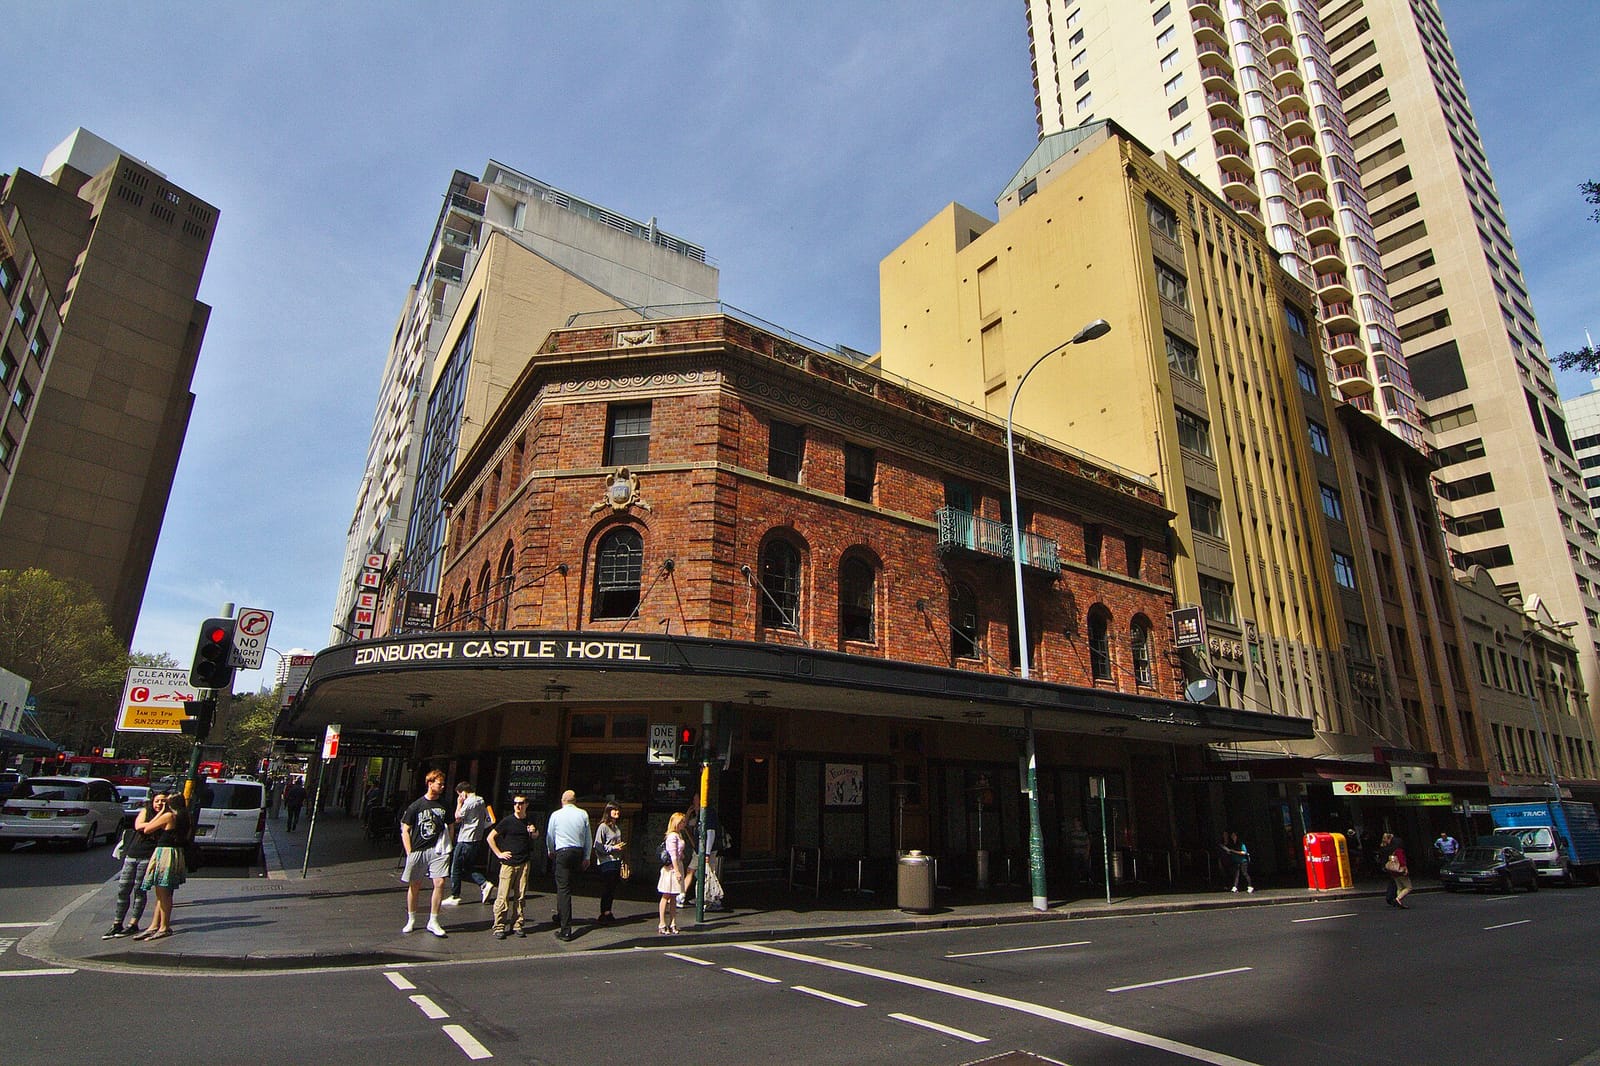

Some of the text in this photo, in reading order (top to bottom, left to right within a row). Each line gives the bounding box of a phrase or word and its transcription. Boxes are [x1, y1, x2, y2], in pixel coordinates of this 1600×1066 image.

[358, 556, 380, 640] CHEMI
[240, 637, 258, 648] NO
[233, 648, 261, 656] RIGHT
[354, 640, 651, 665] EDINBURGH CASTLE HOTEL
[233, 656, 257, 665] TURN
[292, 657, 314, 665] For Lea
[138, 670, 187, 679] CLEARWA
[132, 678, 165, 686] SPECIAL
[134, 688, 146, 702] C
[654, 727, 673, 737] ONE
[653, 739, 674, 748] WAY
